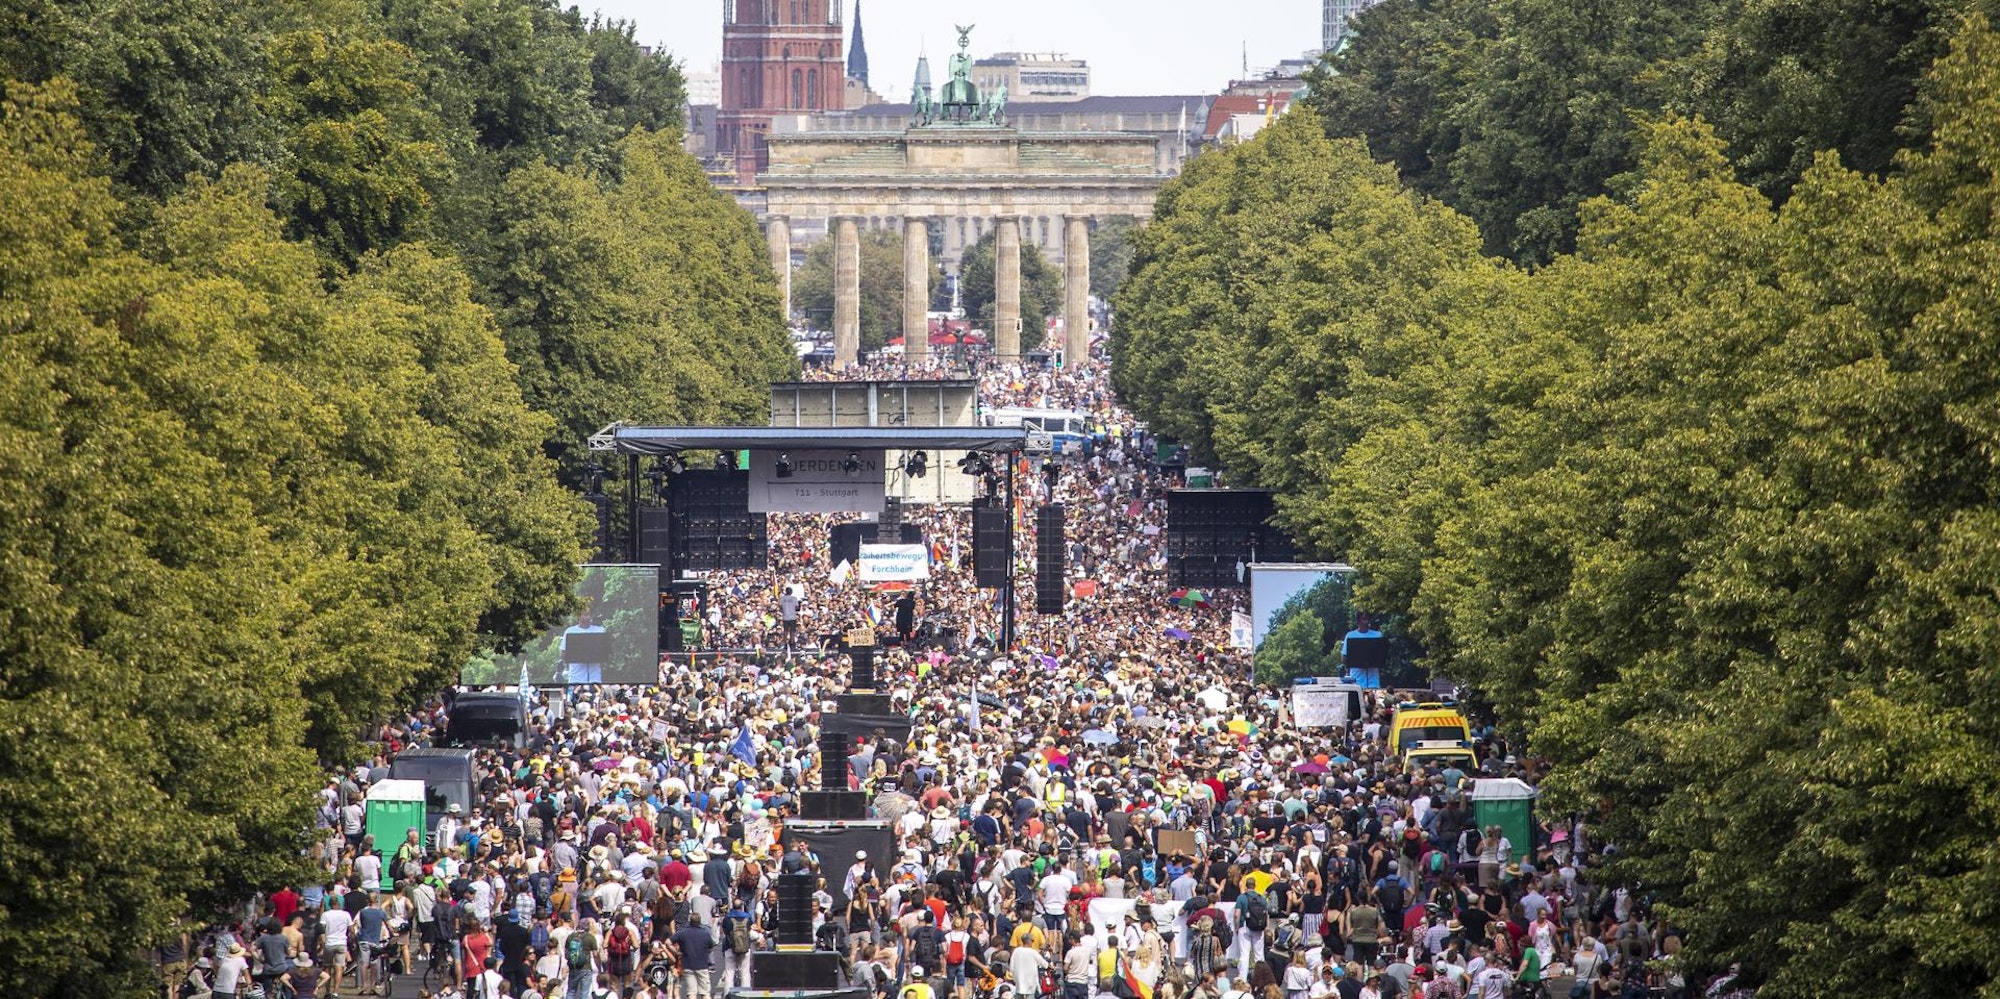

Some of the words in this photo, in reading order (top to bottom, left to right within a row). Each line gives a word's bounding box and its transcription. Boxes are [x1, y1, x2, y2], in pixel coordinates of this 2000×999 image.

[784, 460, 876, 472] UERDENEN
[819, 488, 859, 498] Stuttgart
[872, 565, 914, 573] Forchheim
